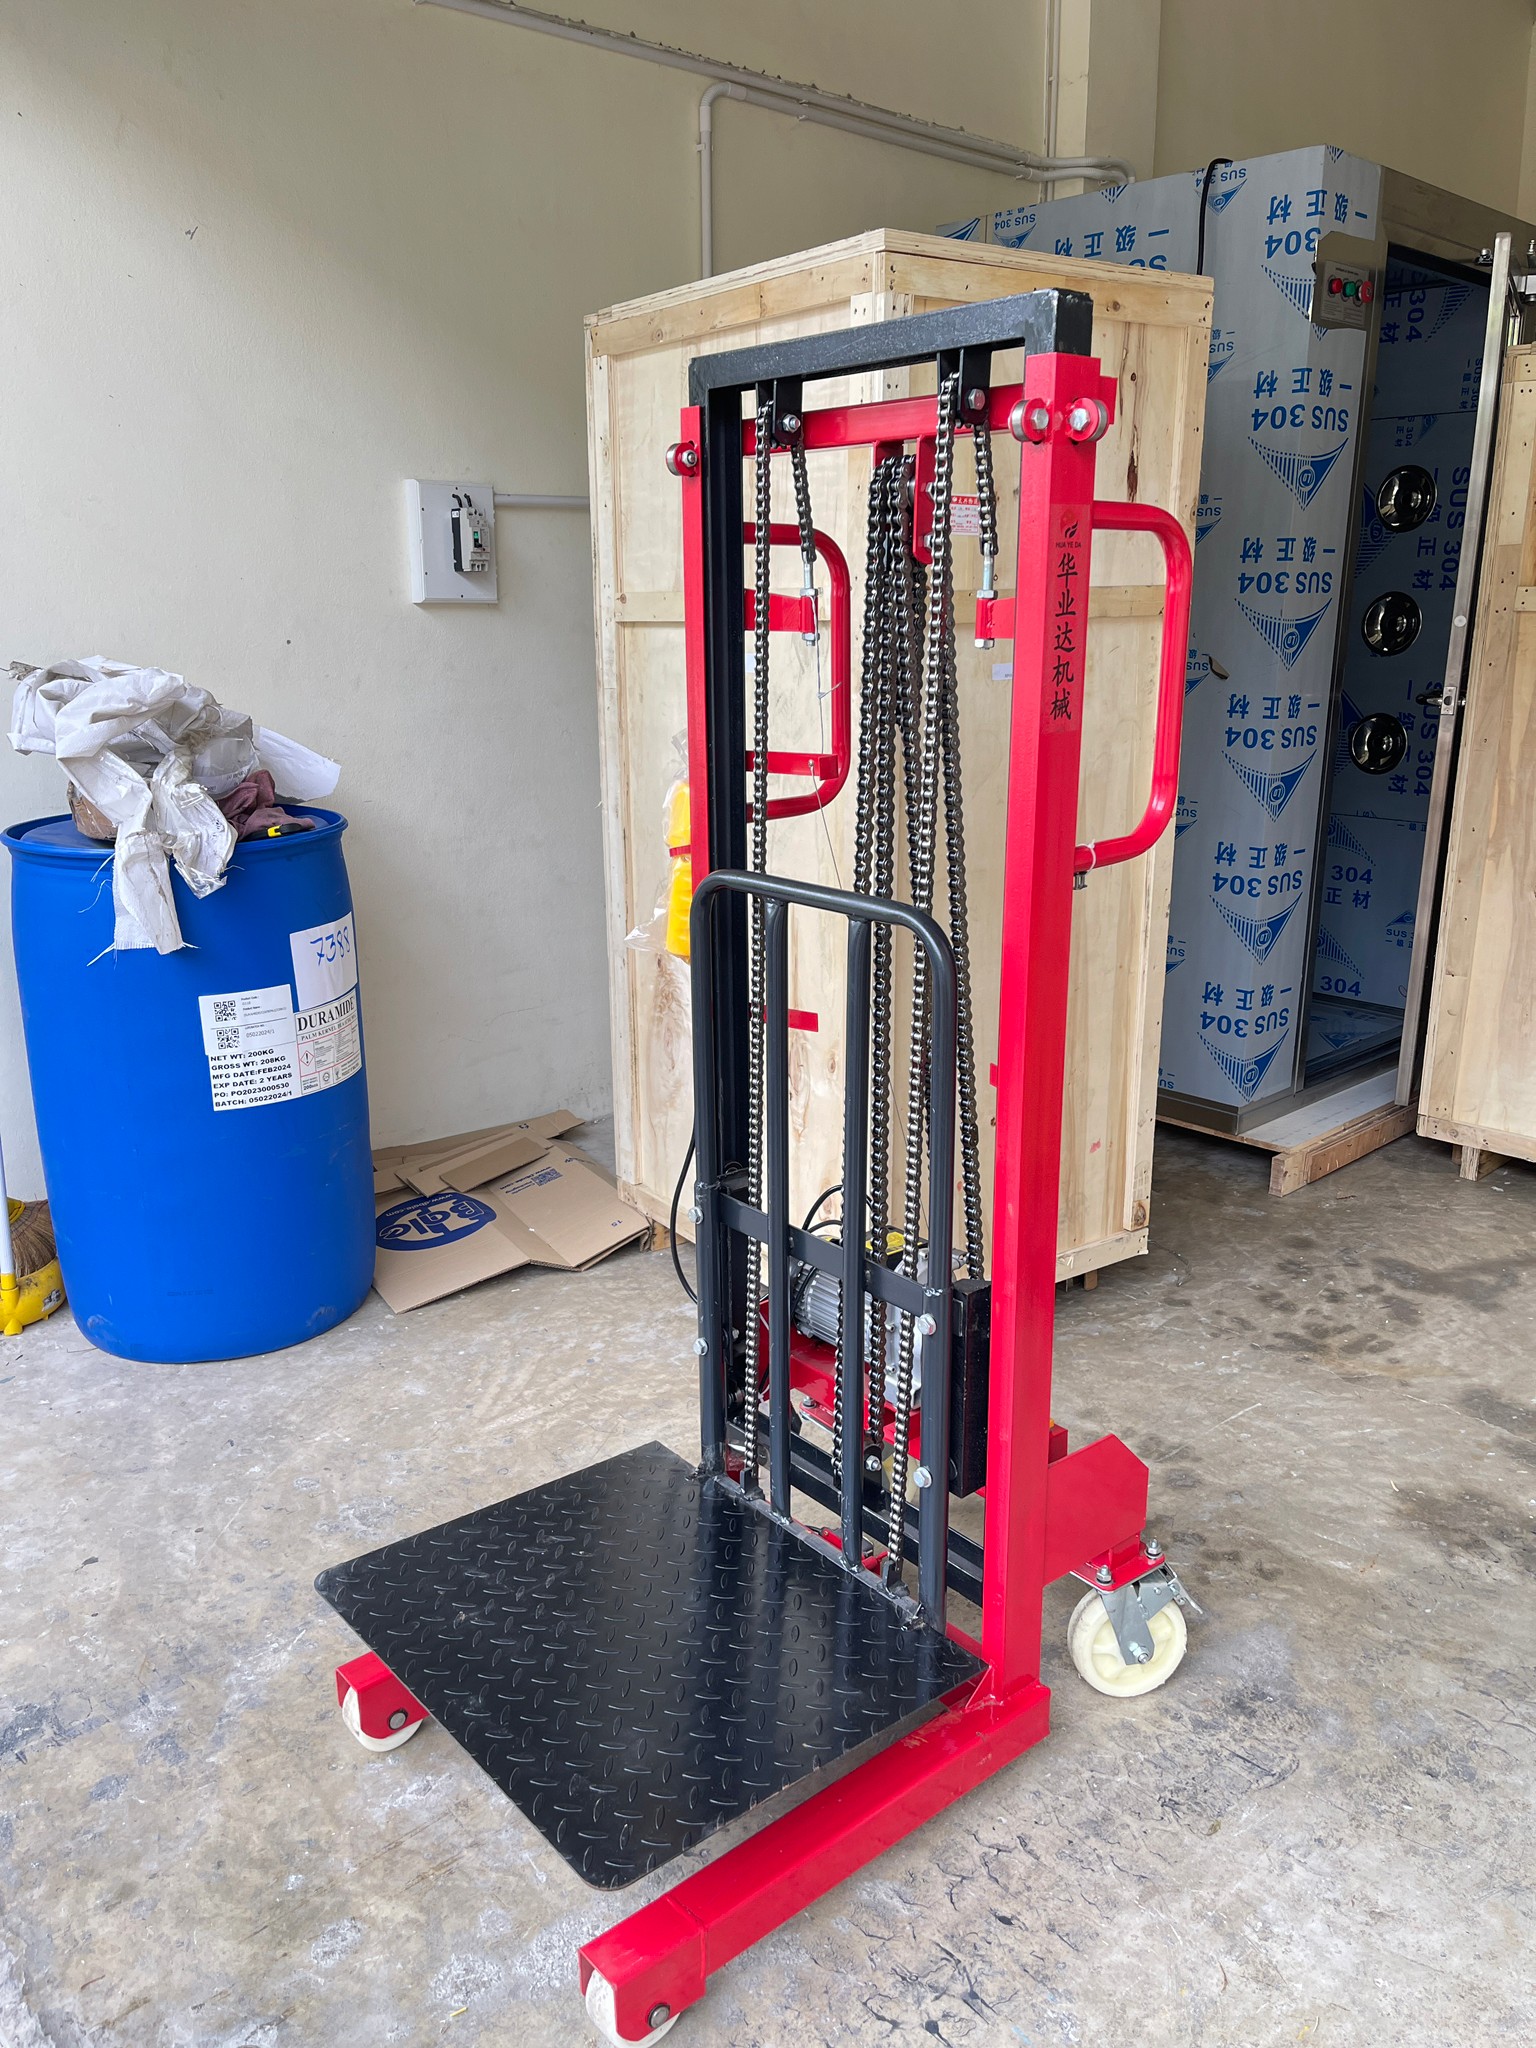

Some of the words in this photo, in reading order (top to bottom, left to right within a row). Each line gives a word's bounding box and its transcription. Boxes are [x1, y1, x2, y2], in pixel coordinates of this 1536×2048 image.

[1195, 173, 1216, 188] 34
[1221, 168, 1247, 182] SUS
[1015, 213, 1036, 226] SUS
[1266, 189, 1368, 226] 一级正材
[994, 219, 1012, 231] 304
[1253, 367, 1352, 399] 一级正材
[1251, 404, 1306, 432] 304
[1311, 405, 1349, 433] SUS
[1446, 466, 1471, 530] SUS
[1196, 506, 1222, 517] SUS
[1240, 536, 1336, 563] 一级正材
[1439, 540, 1463, 592] 304
[1237, 571, 1290, 594] 304
[1295, 571, 1333, 594] SUS
[1050, 552, 1079, 721] 华业达机械
[1227, 693, 1320, 720] 一级正材
[1225, 726, 1276, 750] 304
[1281, 725, 1318, 750] SUS
[1413, 751, 1435, 797] 304
[1214, 841, 1306, 869] 一级正材
[1212, 872, 1262, 898] 304
[1267, 869, 1303, 896] SUS
[1330, 865, 1374, 885] 304
[309, 926, 351, 966] 7388
[1386, 928, 1408, 939] SUS
[1202, 981, 1292, 1011] 一级正材
[1320, 975, 1362, 997] 304
[297, 996, 355, 1032] DURAMIDE
[1200, 1011, 1249, 1038] 304
[1254, 1007, 1290, 1035] SUS
[246, 1028, 275, 1038] 05022024/1
[301, 1032, 317, 1041] PALM
[210, 1054, 228, 1062] NET
[247, 1048, 274, 1058] 200KG
[211, 1063, 241, 1071] GROSS
[242, 1059, 258, 1068] WT:
[260, 1055, 286, 1065] 208KG
[213, 1081, 230, 1089] EXP
[232, 1077, 257, 1087] DATE:
[259, 1076, 265, 1084] 2
[266, 1072, 292, 1082] YEARS
[215, 1099, 247, 1108] BATCH:
[248, 1090, 293, 1104] 05022024/1
